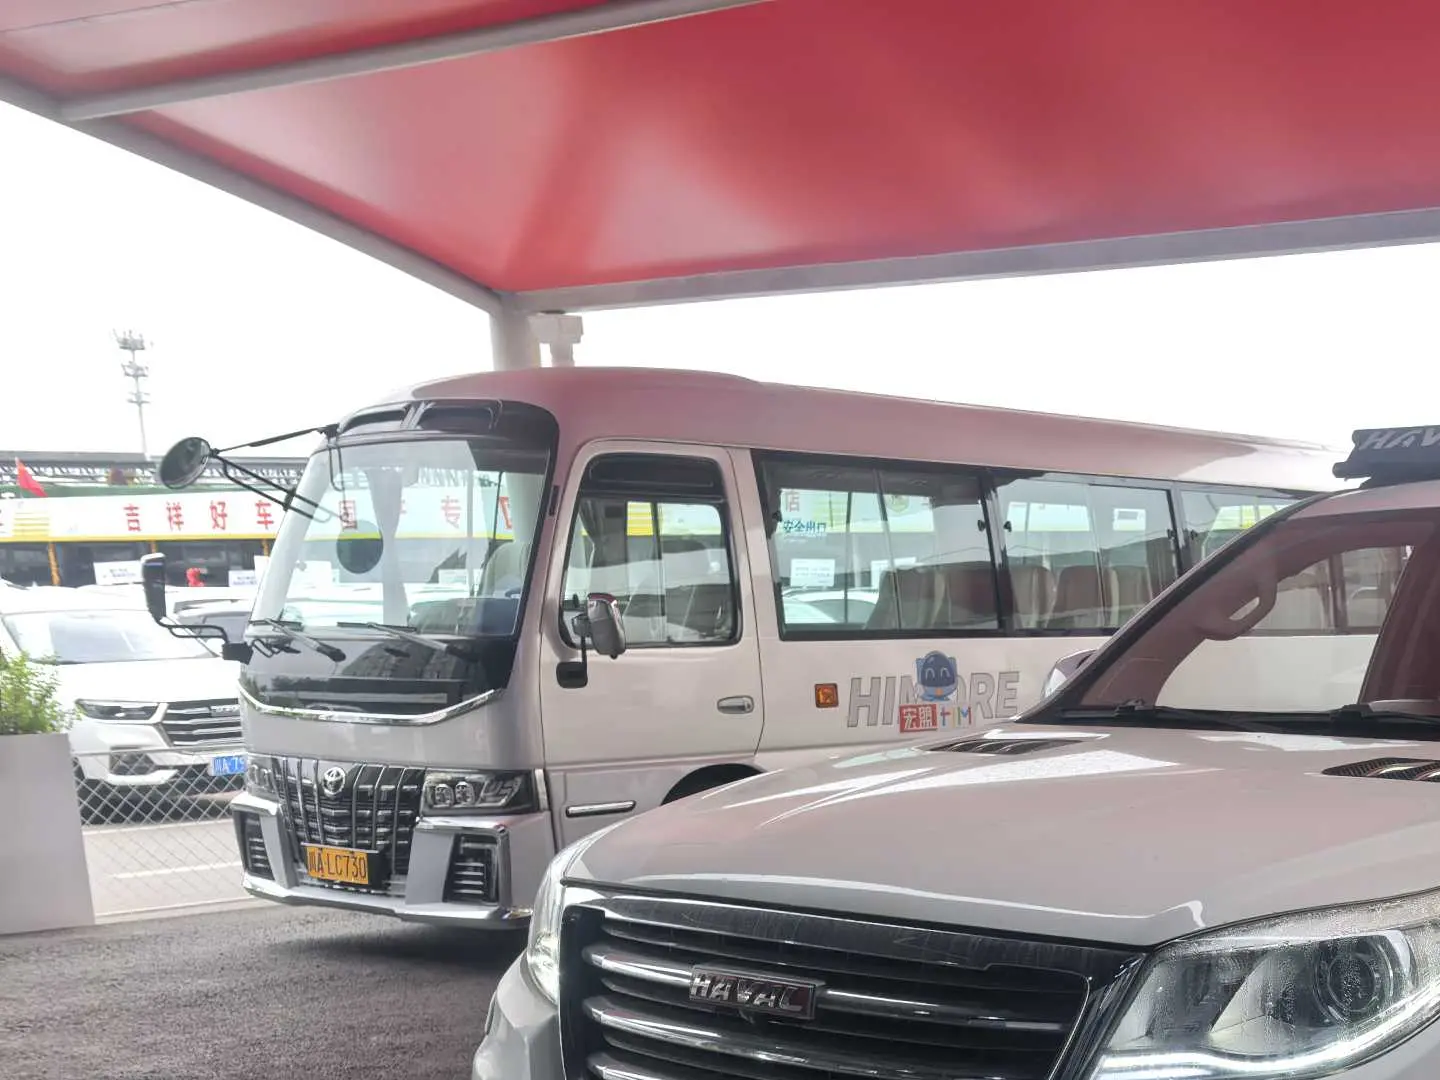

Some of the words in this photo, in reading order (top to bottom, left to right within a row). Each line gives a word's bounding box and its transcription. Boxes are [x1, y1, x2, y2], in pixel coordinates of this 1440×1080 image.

[783, 520, 827, 534] 安全出口
[690, 975, 803, 1012] HAVAL
